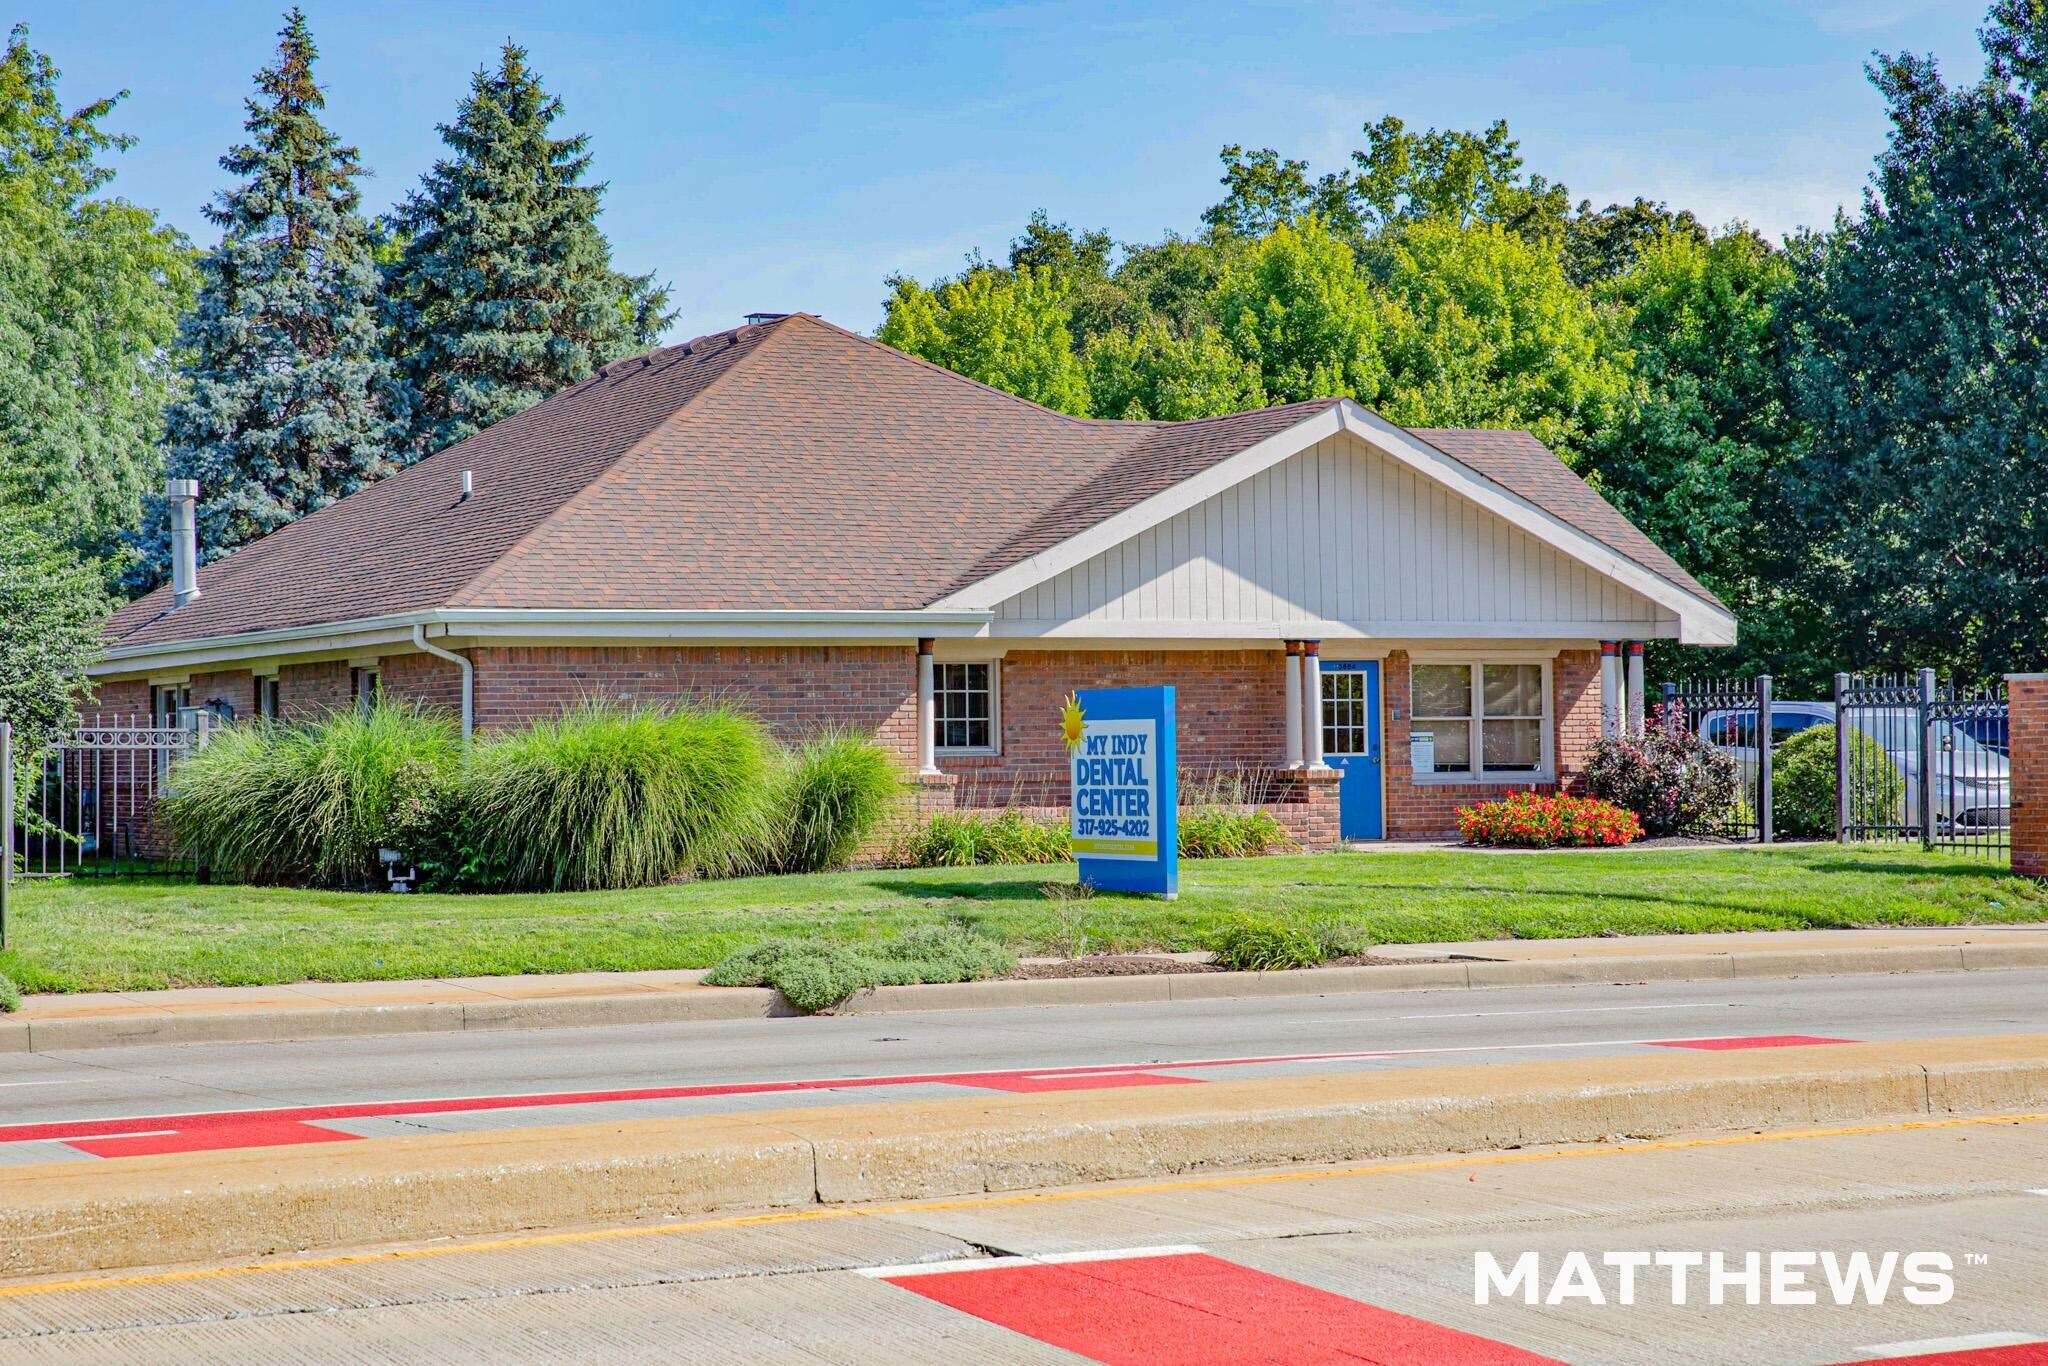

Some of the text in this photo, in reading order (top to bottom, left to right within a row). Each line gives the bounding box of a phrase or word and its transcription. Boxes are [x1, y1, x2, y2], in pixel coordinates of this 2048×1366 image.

[1086, 734, 1148, 755] MY INDY
[1077, 758, 1149, 786] DENTAL
[1077, 788, 1149, 816] CENTER
[1078, 818, 1149, 837] 317-925-4202
